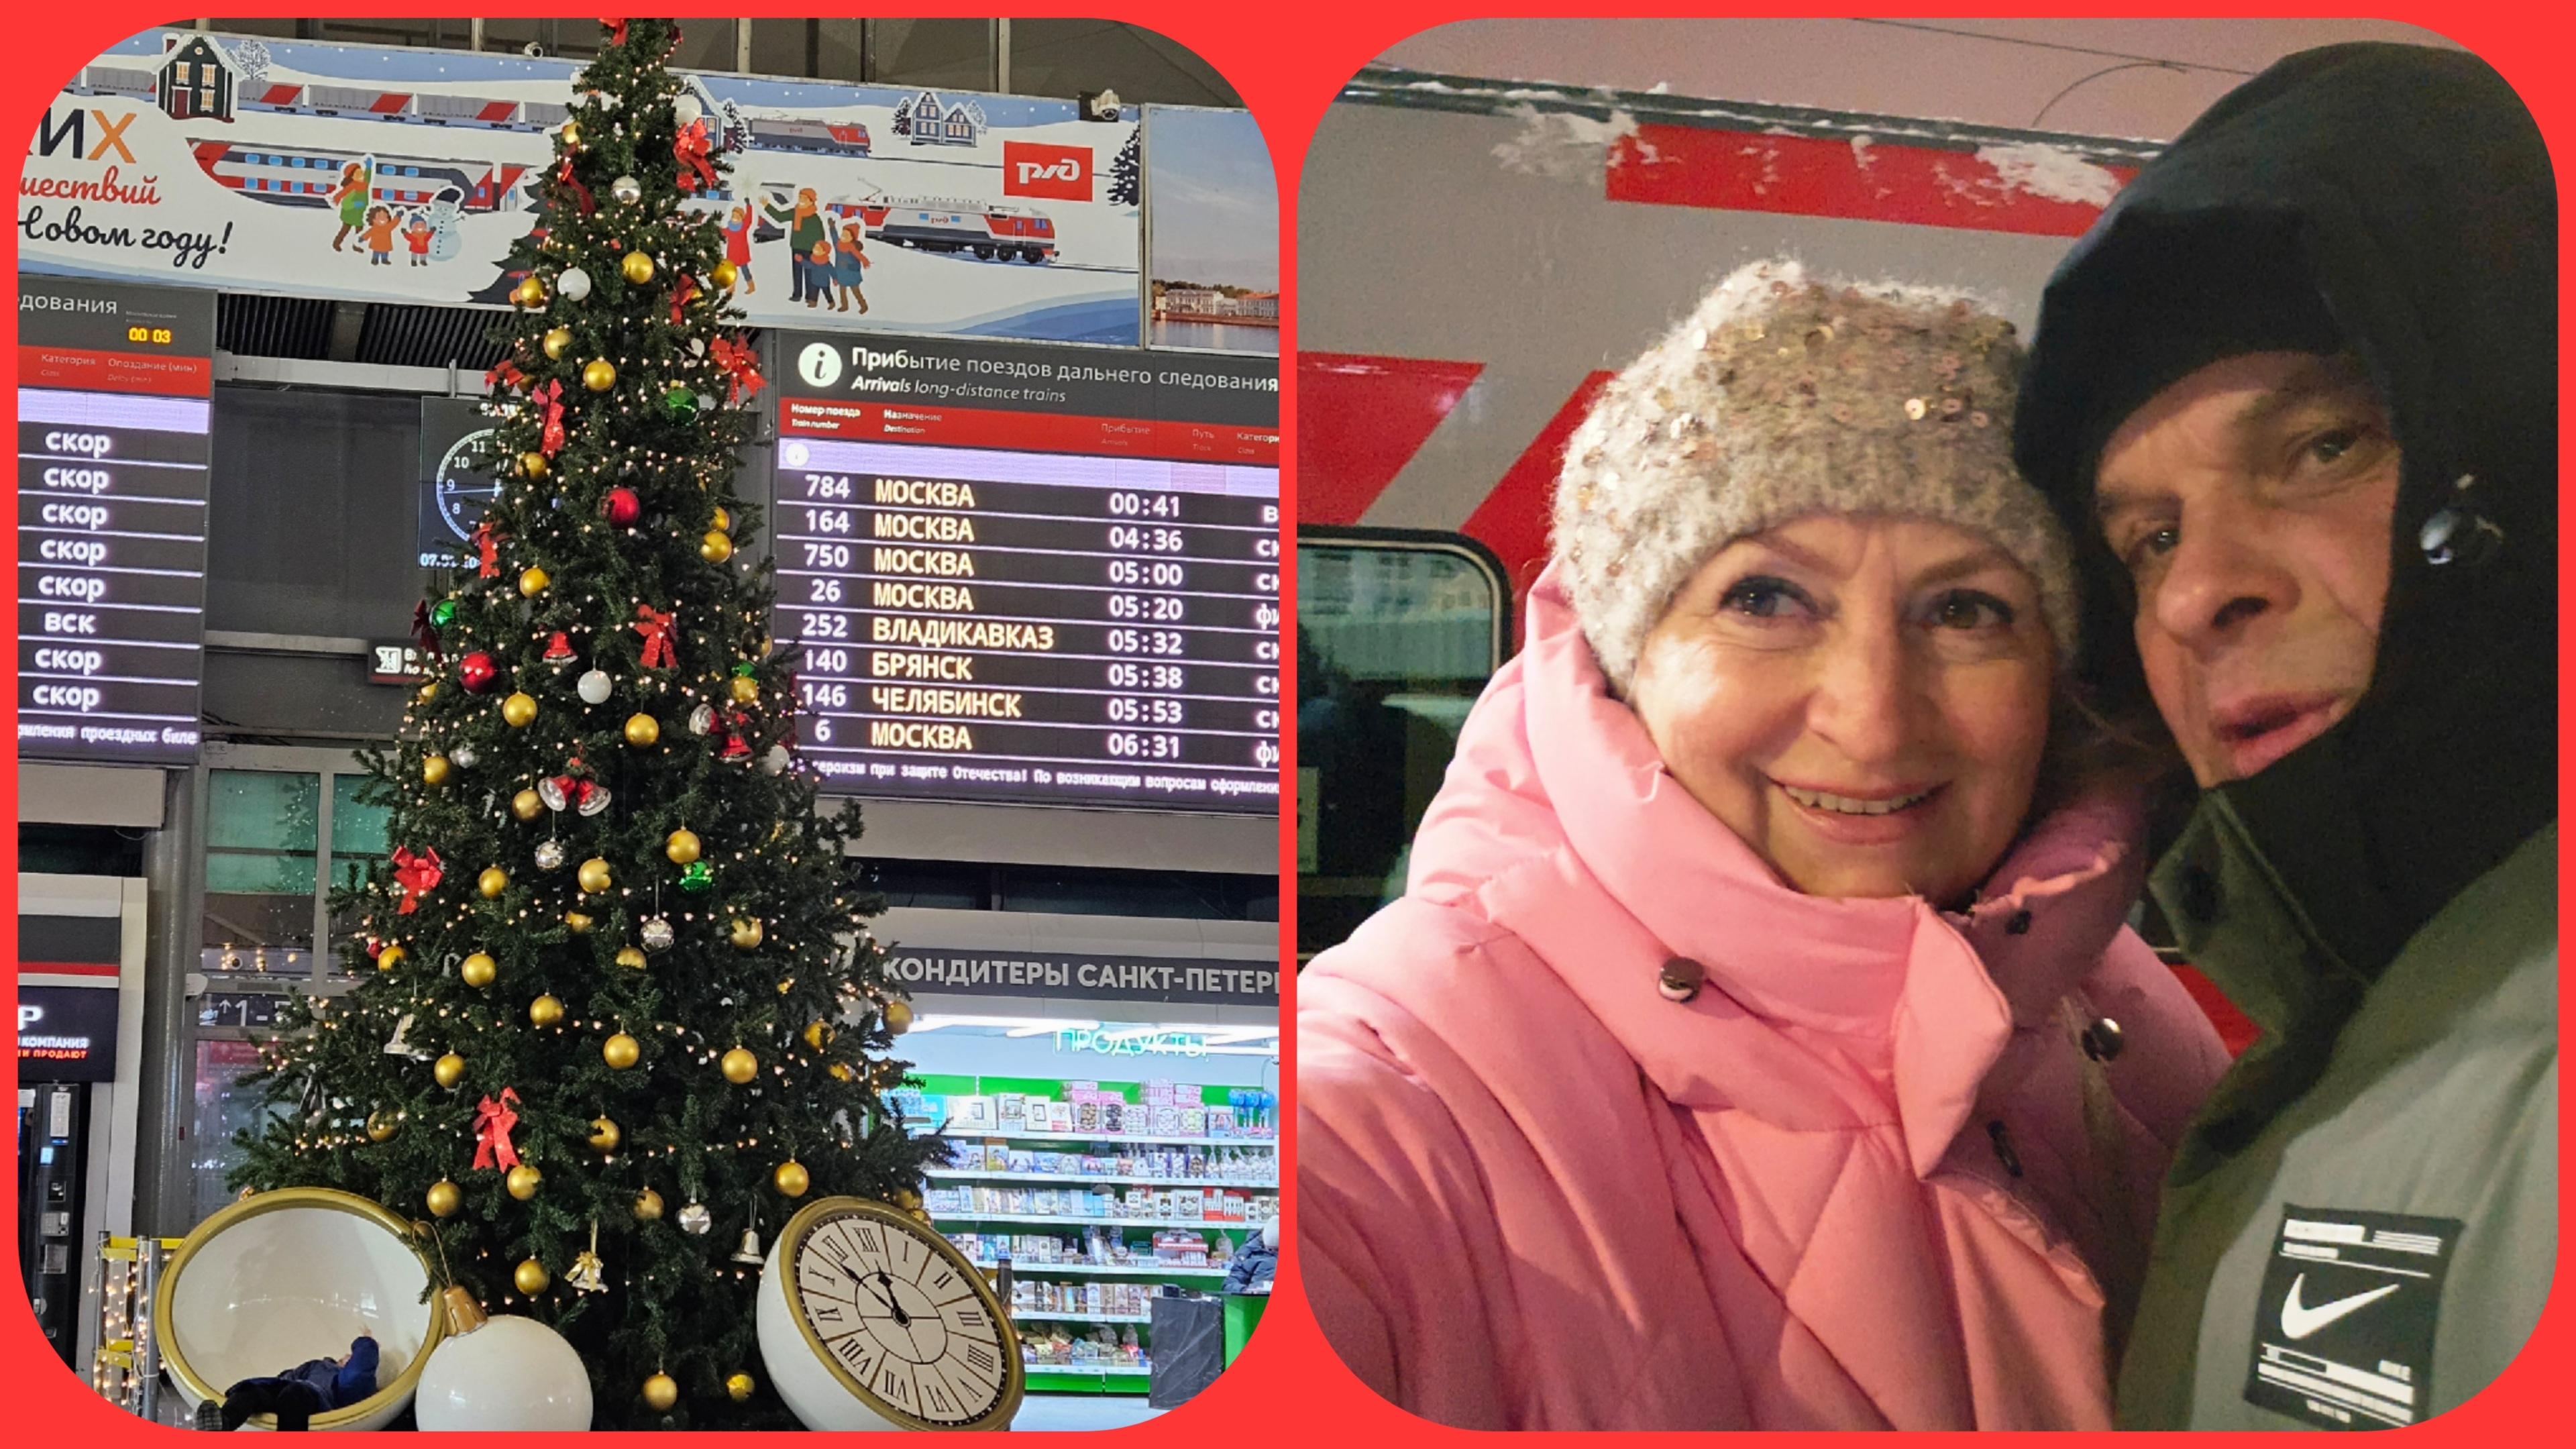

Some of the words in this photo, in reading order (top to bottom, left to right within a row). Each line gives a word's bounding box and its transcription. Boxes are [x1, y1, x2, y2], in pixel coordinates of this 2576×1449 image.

[27, 107, 137, 164] ИХ
[141, 221, 233, 268] году!
[18, 294, 117, 315] дования
[41, 354, 96, 366] Категория
[108, 358, 166, 371] Опоздание
[851, 346, 961, 372] Прибытие
[967, 360, 1052, 379] поездов
[1057, 366, 1151, 384] дальнего
[1159, 371, 1279, 392] следования
[851, 376, 911, 393] Arrivals
[914, 378, 1019, 399] long-distance
[1024, 387, 1066, 402] trains
[791, 403, 824, 416] Номер
[826, 406, 861, 418] поезда
[883, 409, 942, 421] Назначение
[1101, 423, 1150, 435] Прибытие
[1192, 429, 1215, 439] Путь
[792, 419, 810, 427] Train
[883, 424, 926, 433] Destination
[46, 432, 111, 459] скор
[471, 441, 486, 453] 11
[453, 457, 470, 469] 10
[44, 468, 109, 495] скор
[446, 478, 455, 492] 9
[451, 502, 461, 515] 8
[805, 474, 851, 499] 784
[875, 478, 975, 508] МОСКВА
[1109, 492, 1180, 517] 00:41
[42, 504, 108, 530] скор
[805, 509, 851, 534] 164
[875, 513, 975, 542] МОСКВА
[1109, 526, 1183, 552] 04:36
[40, 539, 107, 566] скор
[804, 543, 850, 568] 750
[874, 547, 975, 577] МОСКВА
[1109, 561, 1183, 586] 05:00
[38, 576, 105, 602] скор
[810, 579, 841, 602] 26
[873, 582, 974, 611] МОСКВА
[1109, 594, 1184, 621] 05:20
[44, 612, 97, 634] вск
[802, 613, 848, 637] 252
[873, 617, 1055, 650] ВЛАДИКАВКАЗ
[1108, 629, 1183, 655] 05:32
[35, 649, 102, 676] скор
[804, 649, 848, 672] 140
[872, 651, 973, 681] БРЯНСК
[1108, 663, 1183, 690] 05:38
[33, 685, 100, 712] скор
[802, 684, 847, 707] 146
[872, 686, 1022, 718] ЧЕЛЯБИНСК
[1108, 698, 1183, 724] 05:53
[162, 728, 198, 745] биле
[815, 719, 831, 742] 6
[871, 721, 973, 751] МОСКВА
[1108, 733, 1180, 759] 06:31
[870, 763, 896, 780] при
[900, 764, 948, 780] защите
[1034, 769, 1052, 784] По
[1145, 775, 1206, 794] вопросам
[883, 957, 1069, 987] КОНДИТЕРЫ
[1077, 963, 1279, 994] САНКТ-ПЕТЕР
[21, 1036, 90, 1049] КОМПАНИЯ
[34, 1049, 87, 1059] ПРОДАЮТ
[1056, 1028, 1207, 1057] ПРОДУКТЫ
